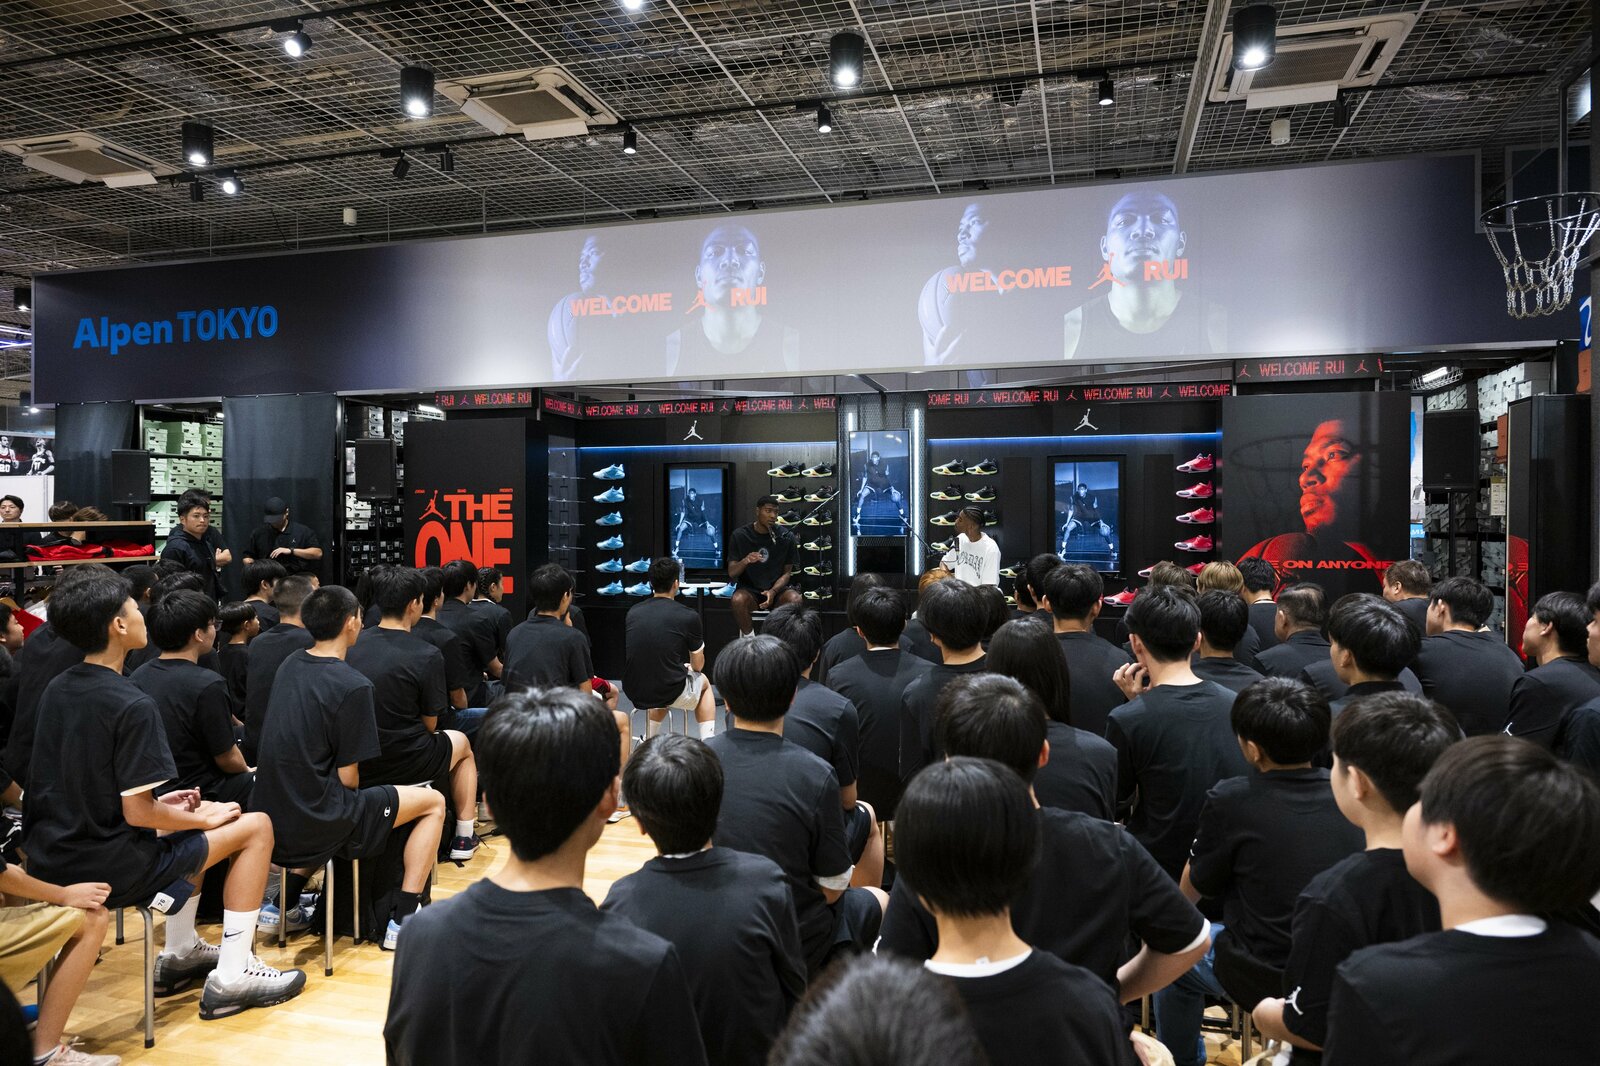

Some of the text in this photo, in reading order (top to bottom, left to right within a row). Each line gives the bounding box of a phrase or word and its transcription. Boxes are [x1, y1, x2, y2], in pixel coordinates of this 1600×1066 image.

[948, 258, 1189, 293] WELCOME RUI
[571, 286, 767, 317] WELCOME RUI
[72, 305, 279, 355] Alpen TOKYO
[1259, 360, 1345, 377] WELCOME RUI
[474, 392, 515, 406] WELCOME
[517, 391, 532, 404] RUI
[954, 392, 970, 405] RUI
[993, 389, 1040, 403] WELCOME
[1043, 389, 1059, 402] RUI
[1084, 387, 1133, 400] WELCOME
[1136, 386, 1153, 399] RUI
[1178, 384, 1231, 397] WELCOME
[585, 405, 623, 417] WELCOME
[625, 404, 639, 416] RUI
[658, 402, 698, 414] WELCOME
[700, 401, 714, 413] RUI
[734, 399, 776, 412] WELCOME
[777, 398, 793, 410] RUI
[443, 493, 513, 521] THE
[414, 520, 514, 594] ONE
[1282, 560, 1313, 569] ON
